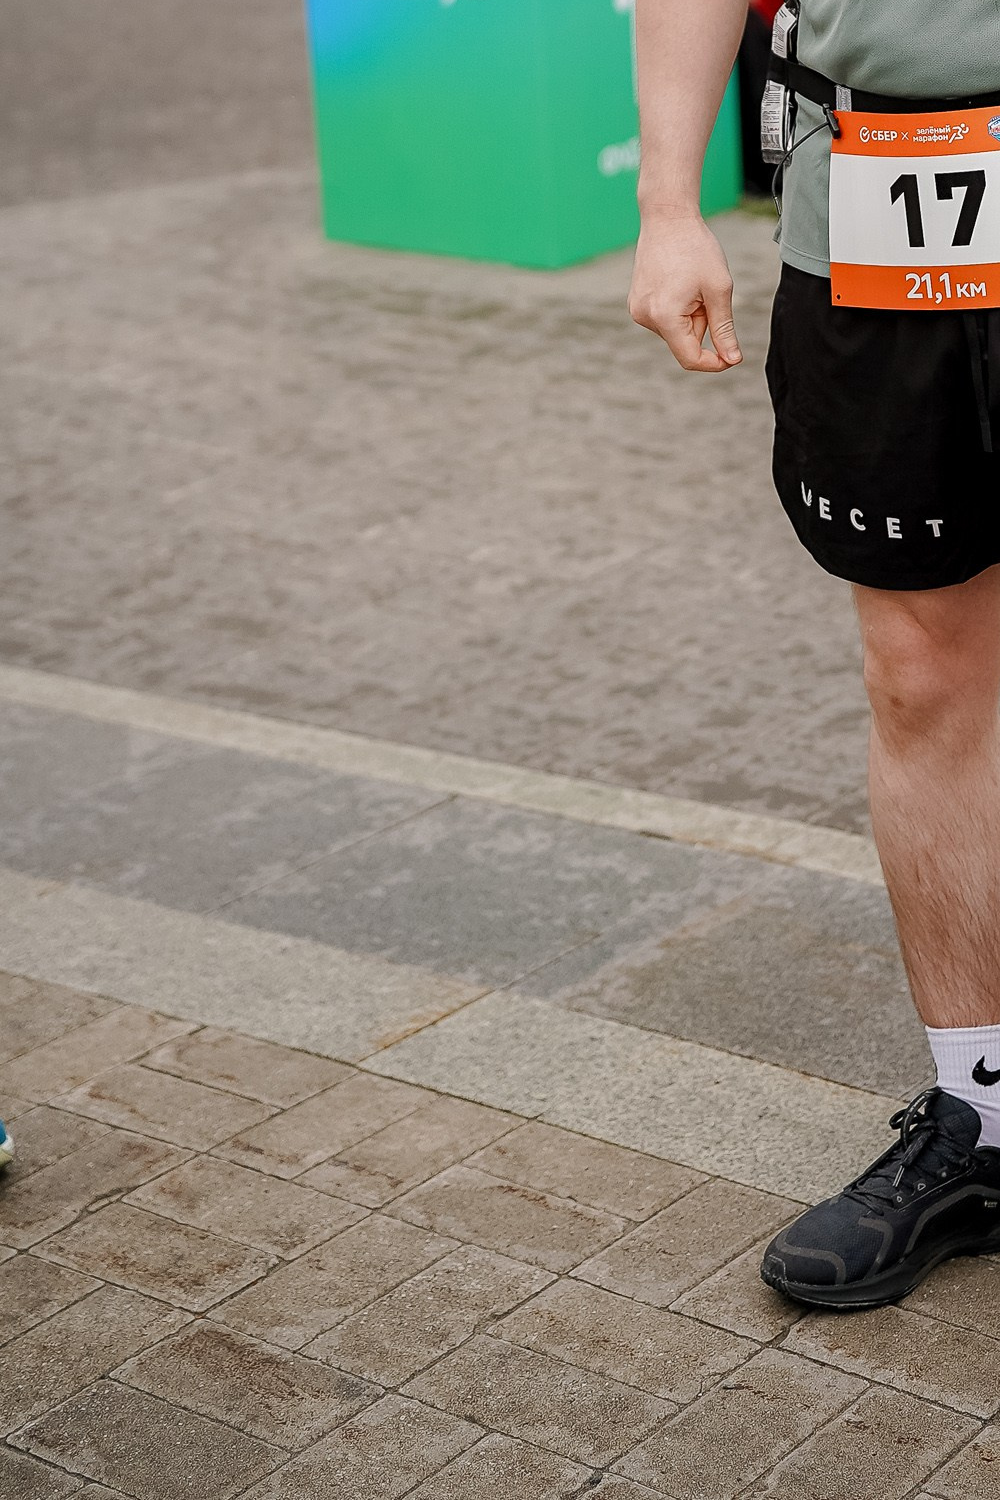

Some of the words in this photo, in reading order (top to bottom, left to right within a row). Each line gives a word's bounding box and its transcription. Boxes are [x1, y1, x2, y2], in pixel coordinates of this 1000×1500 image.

[870, 129, 898, 142] СБЕР
[916, 124, 951, 135] зелёный
[912, 133, 949, 143] марафон
[889, 169, 987, 248] 17
[905, 272, 952, 303] 21,1
